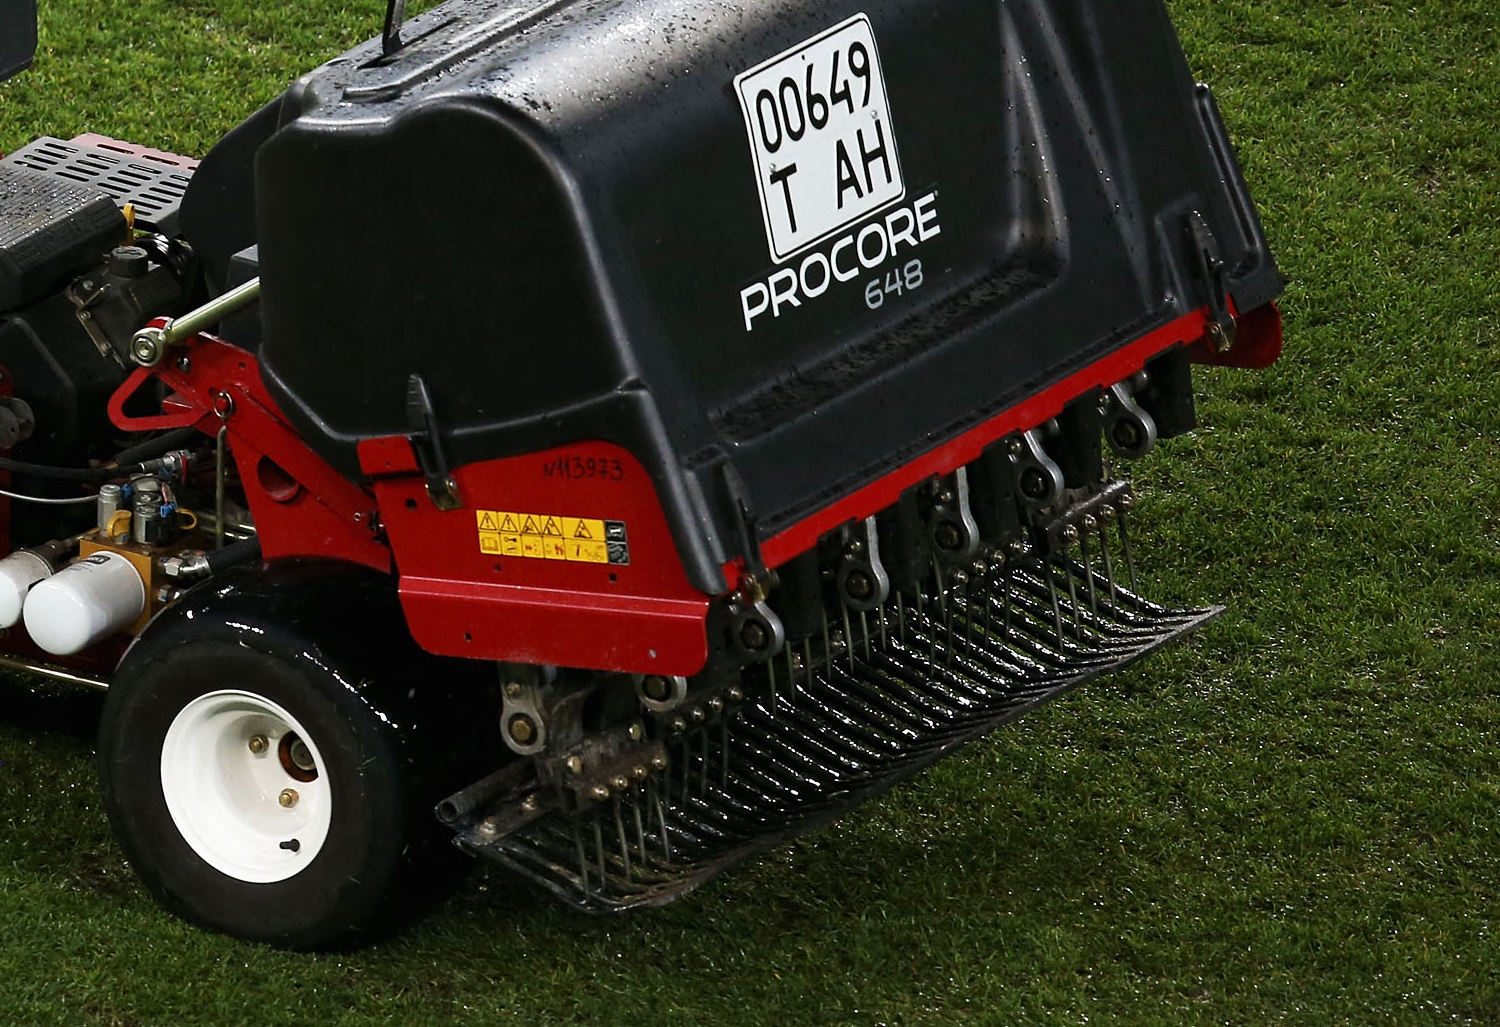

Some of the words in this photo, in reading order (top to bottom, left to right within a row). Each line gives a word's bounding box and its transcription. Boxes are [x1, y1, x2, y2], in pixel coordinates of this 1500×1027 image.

[755, 40, 871, 154] 00649
[769, 162, 797, 234] T
[836, 118, 892, 210] AH
[740, 191, 941, 332] PROCORE
[864, 258, 924, 309] 648
